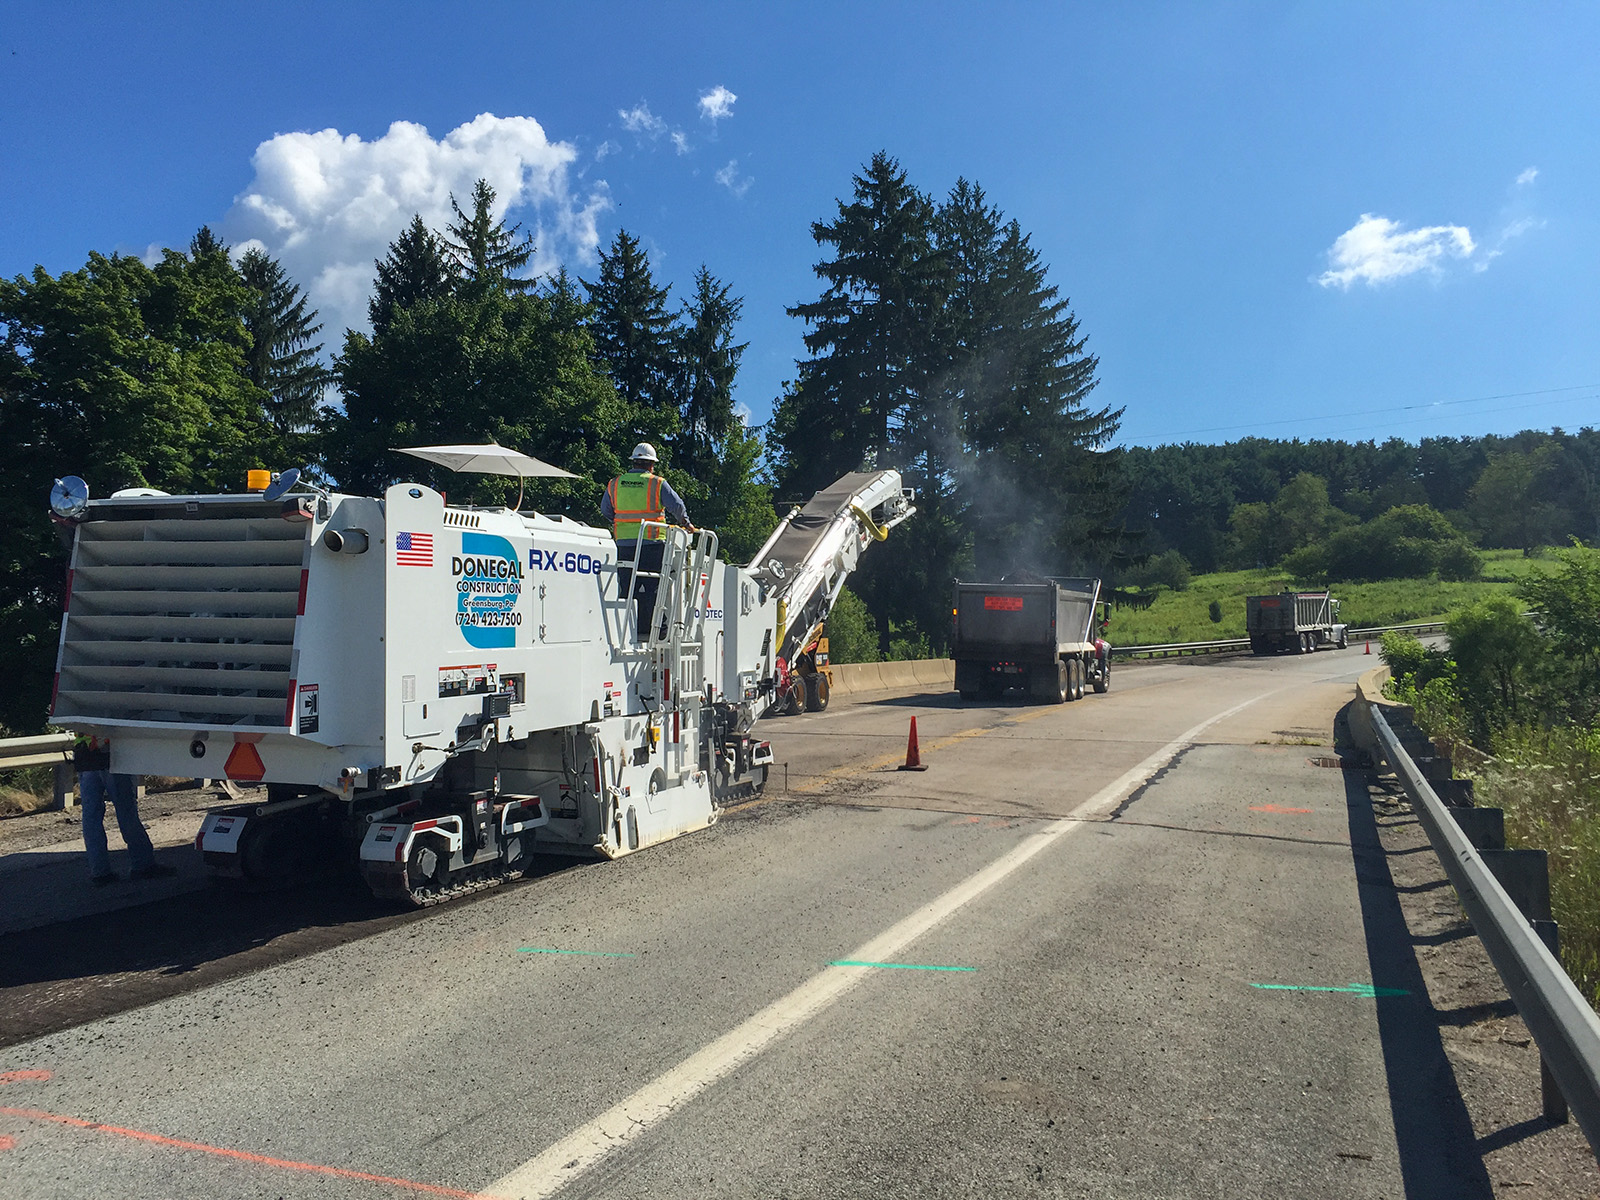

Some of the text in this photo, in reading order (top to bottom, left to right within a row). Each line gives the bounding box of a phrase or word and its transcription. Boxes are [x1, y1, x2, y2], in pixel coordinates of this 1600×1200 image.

[452, 557, 524, 579] DONEGAL
[529, 549, 602, 574] RX-60e
[456, 581, 521, 594] CONSTRUCTION
[463, 599, 505, 609] Greensburg,
[455, 612, 522, 626] (724) 423-7500
